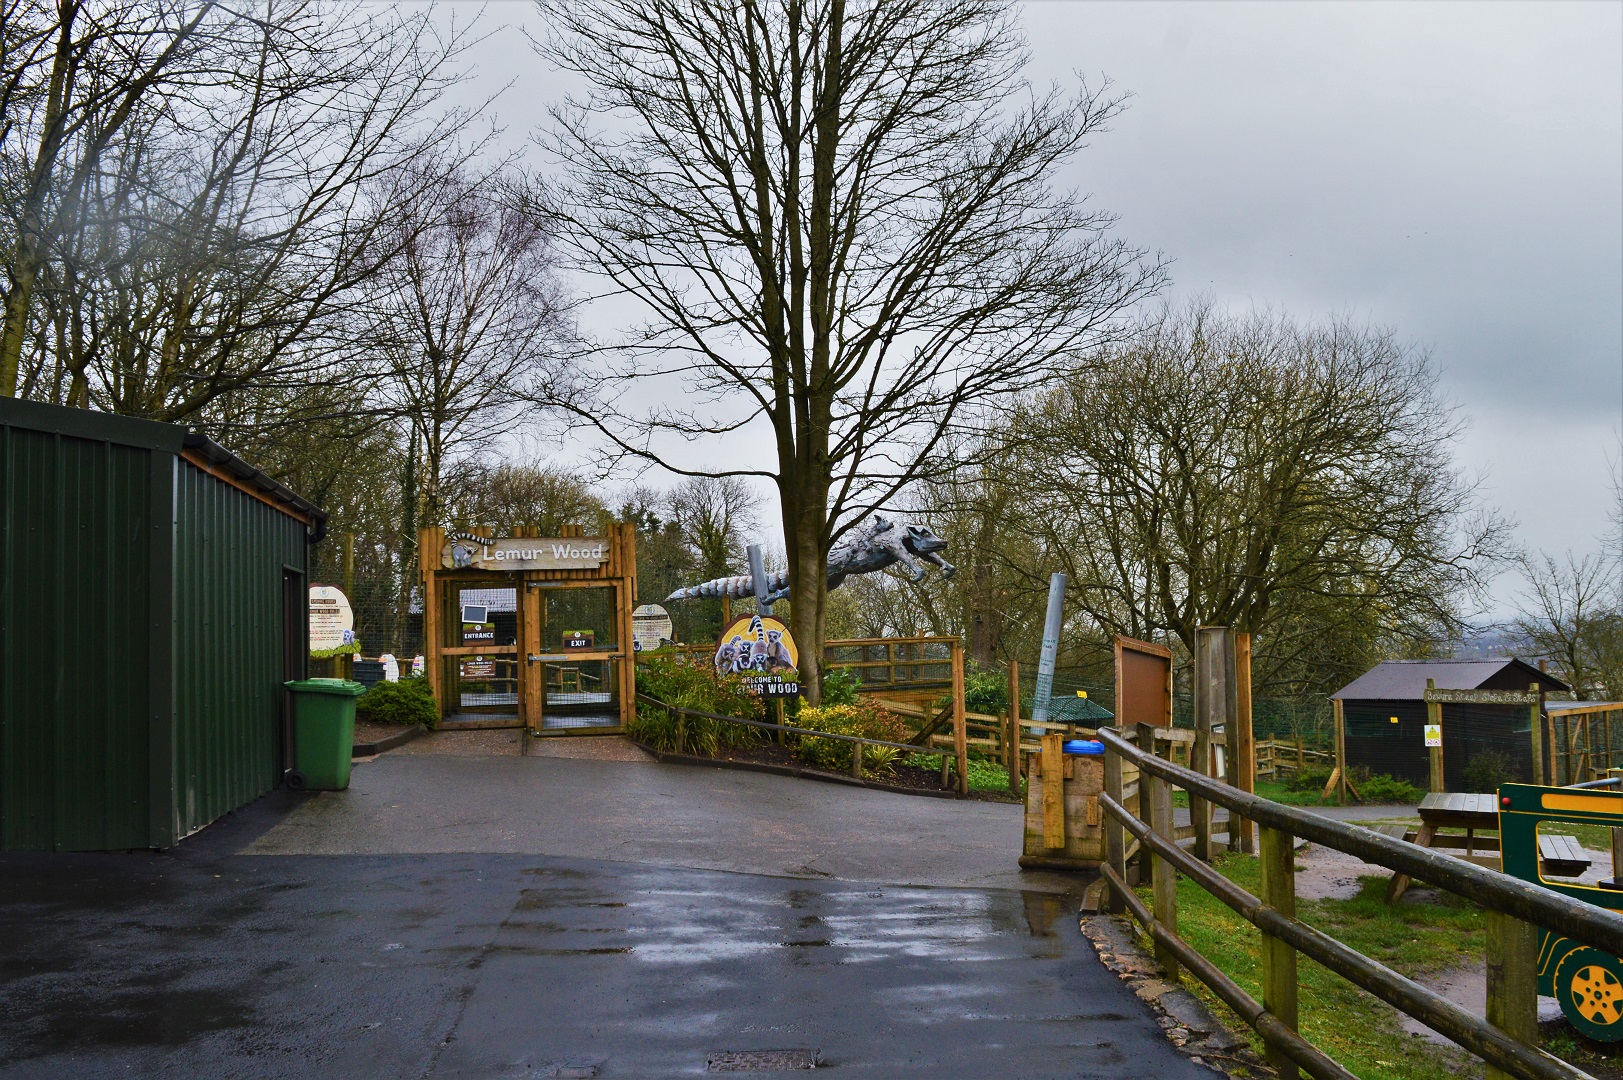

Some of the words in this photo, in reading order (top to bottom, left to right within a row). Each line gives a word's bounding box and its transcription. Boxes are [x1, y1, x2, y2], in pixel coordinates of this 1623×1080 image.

[483, 545, 543, 561] Lemur
[551, 543, 602, 560] Wood
[768, 682, 798, 694] WOOD
